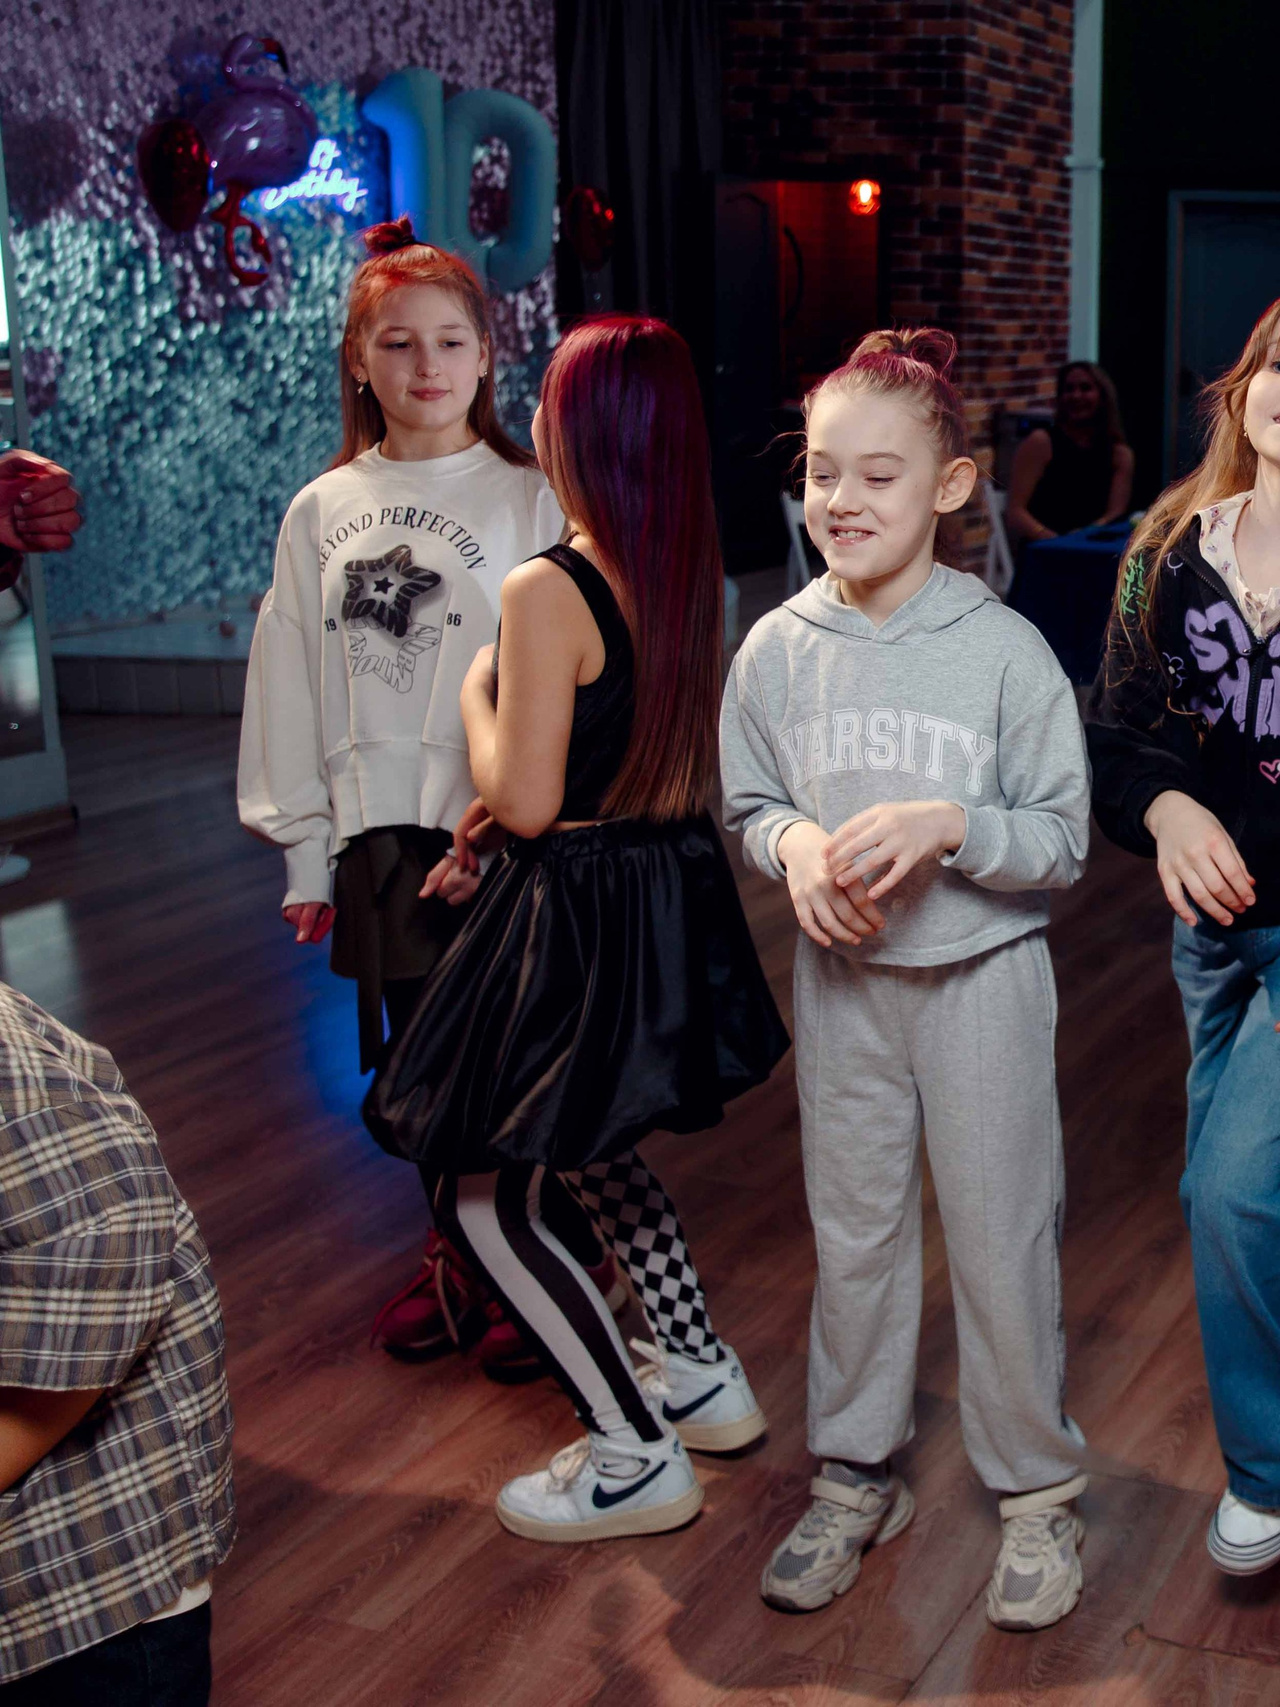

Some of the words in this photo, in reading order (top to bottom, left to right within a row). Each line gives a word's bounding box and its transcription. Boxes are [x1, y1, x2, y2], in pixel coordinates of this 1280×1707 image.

[320, 513, 373, 573] BEYOND
[379, 506, 487, 571] PERFECTION
[324, 618, 337, 632] 19
[446, 613, 462, 627] 86
[778, 707, 997, 796] VARSITY
